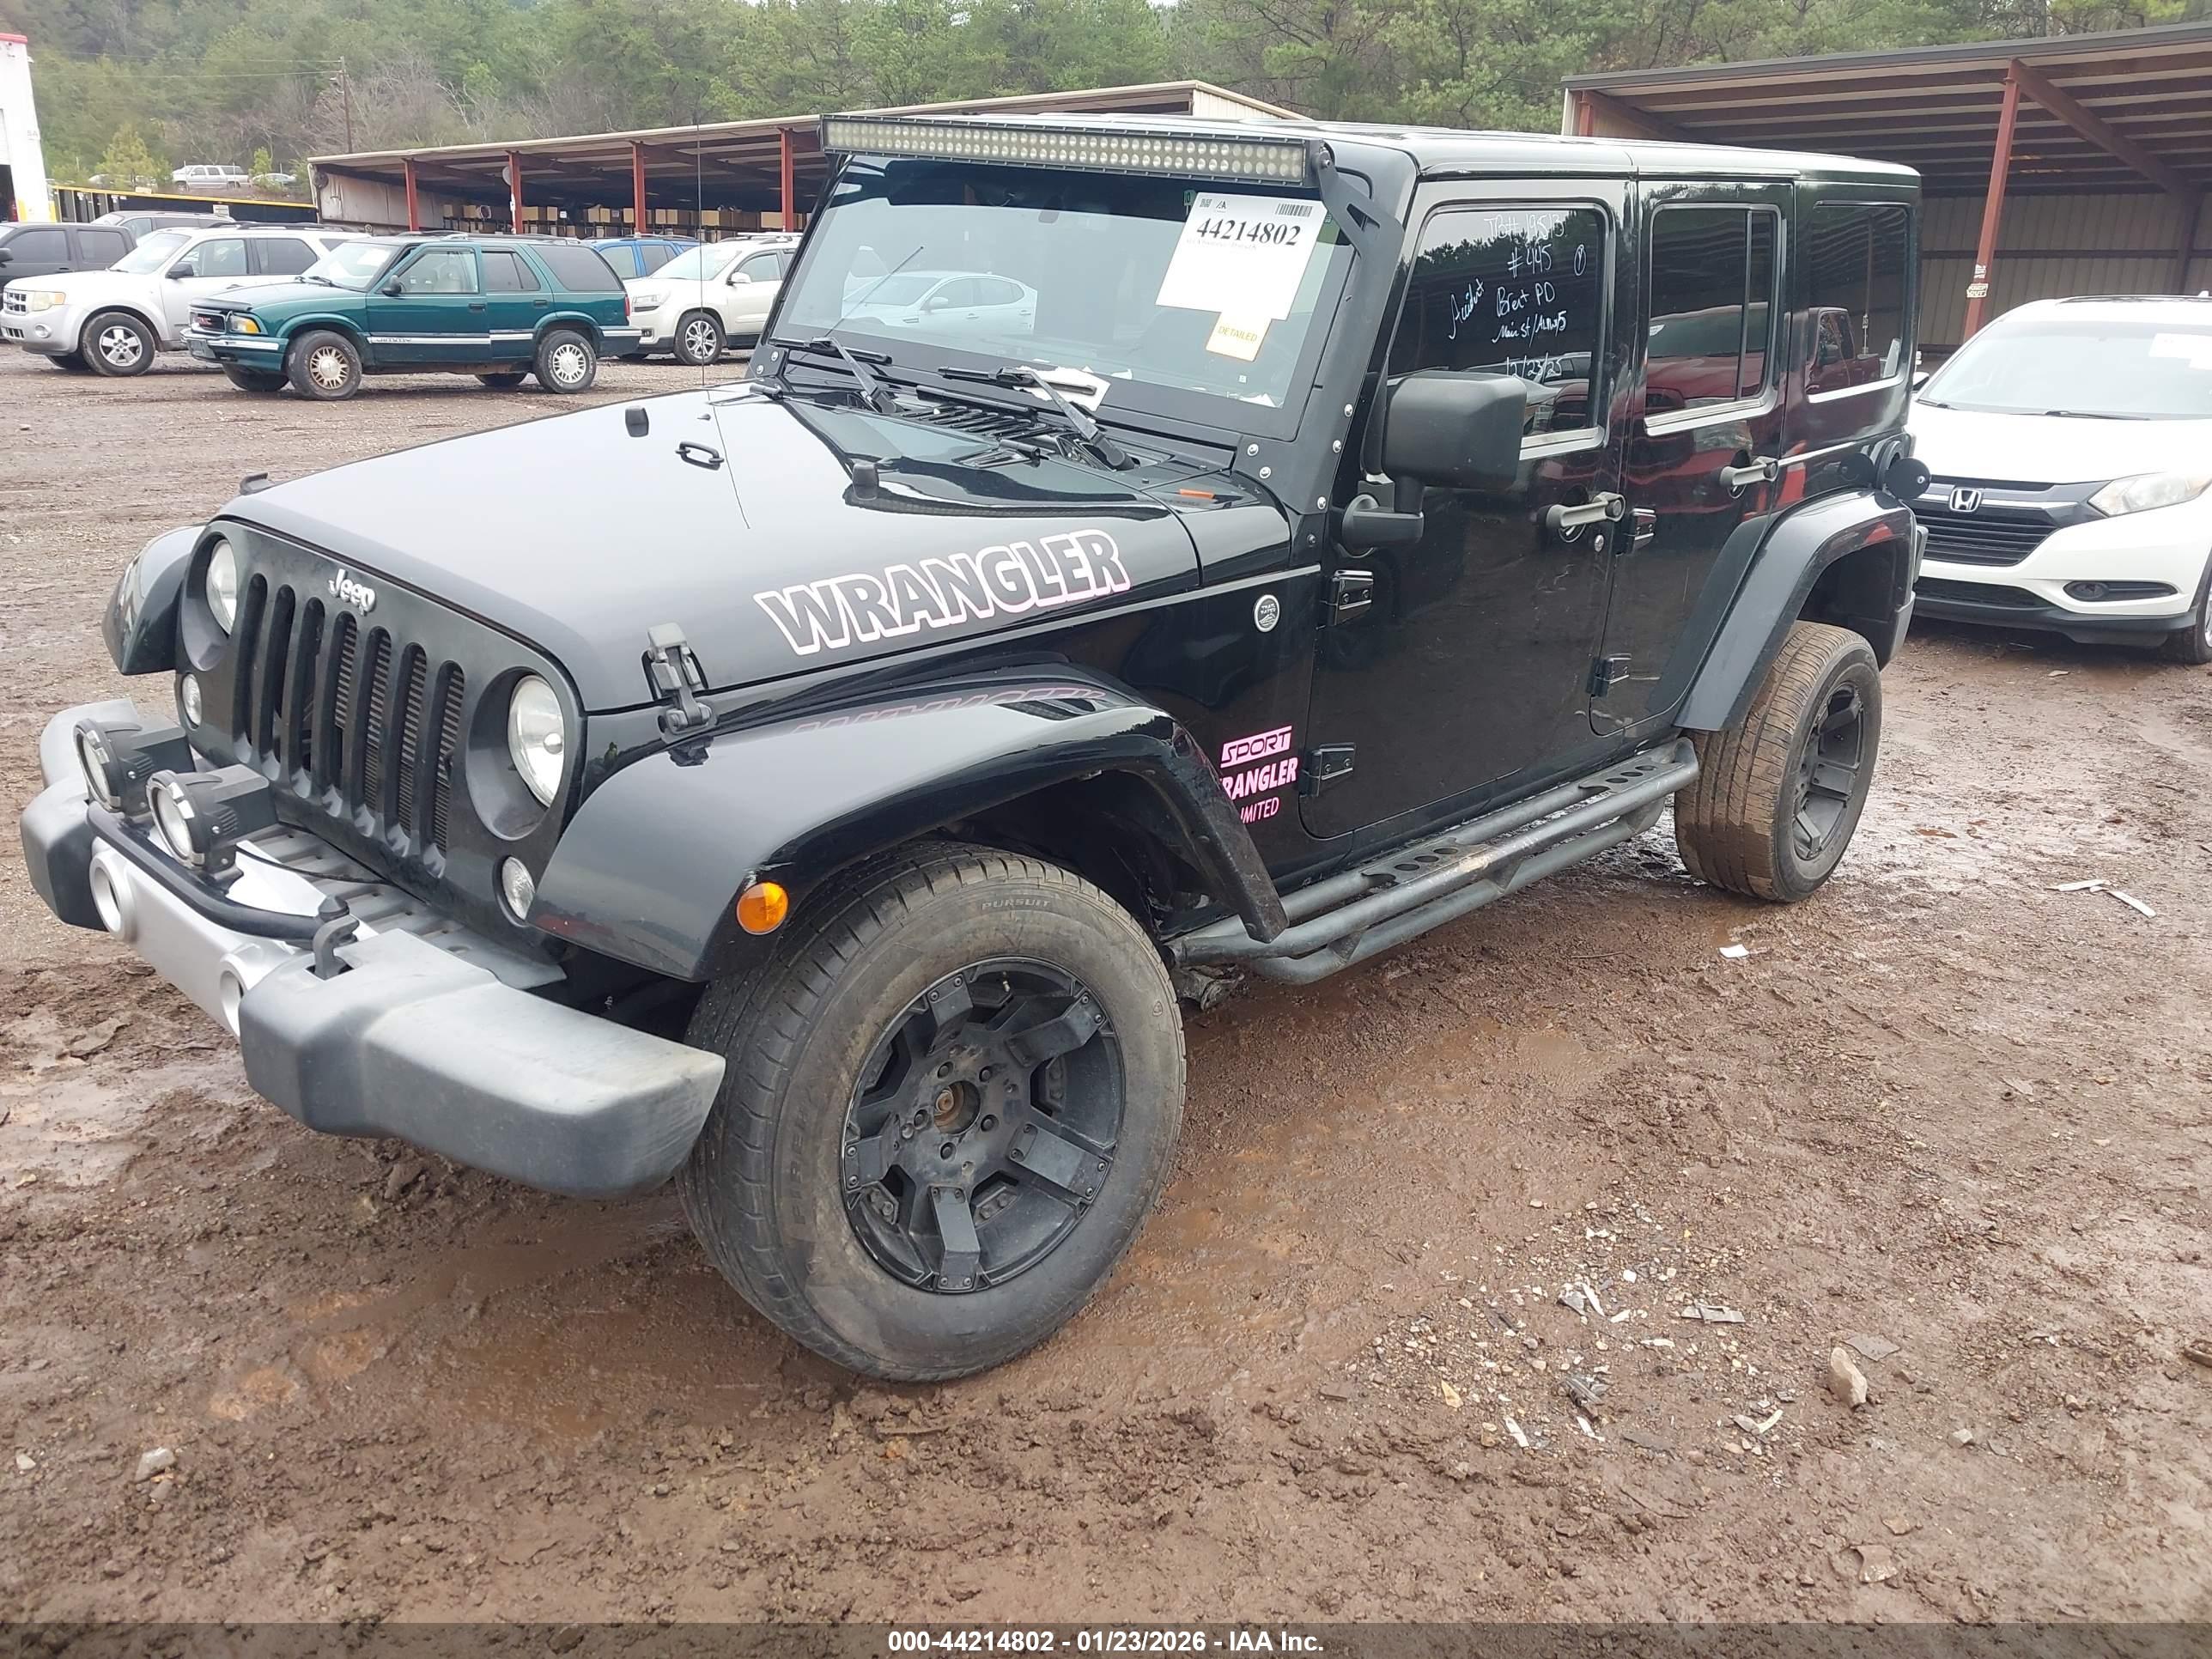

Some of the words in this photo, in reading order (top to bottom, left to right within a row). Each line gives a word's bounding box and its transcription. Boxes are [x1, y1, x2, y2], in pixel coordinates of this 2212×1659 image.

[1197, 218, 1301, 246] 44214802
[1534, 282, 1556, 306] PD
[1218, 325, 1258, 343] DETAILED
[1506, 352, 1563, 384] 12/23/25
[328, 568, 376, 616] Jeep
[754, 529, 1132, 655] WRANGLER
[1220, 726, 1292, 768] SPORT
[1220, 757, 1299, 801] RANGLER
[981, 897, 1051, 910] PURSUIT
